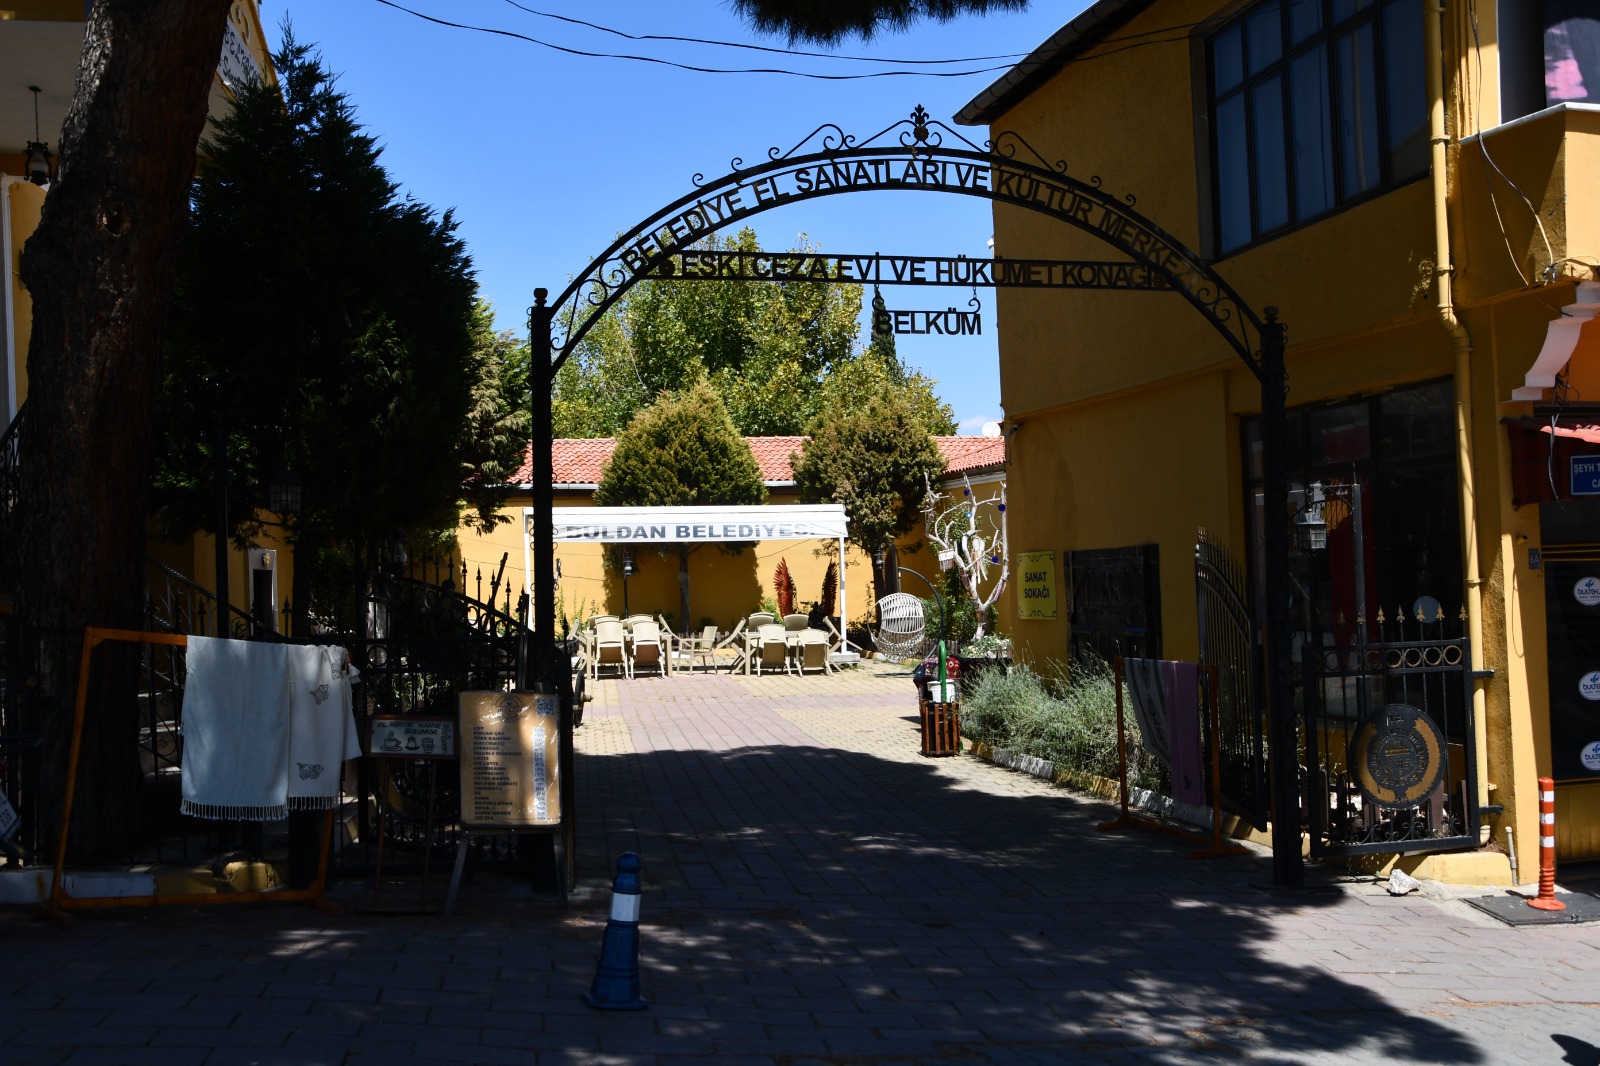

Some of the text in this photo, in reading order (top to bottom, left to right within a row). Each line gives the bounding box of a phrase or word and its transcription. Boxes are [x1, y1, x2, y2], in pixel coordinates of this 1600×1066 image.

[621, 188, 746, 274] BELEDİYE
[752, 176, 790, 205] EL
[795, 159, 946, 195] SANATLARI
[953, 163, 990, 191] VE
[998, 170, 1093, 224] KÜLTÜR
[889, 258, 926, 282] VE
[936, 255, 1057, 286] HÜKÜMET
[875, 308, 981, 335] BELKÜM
[1573, 463, 1595, 475] ŞEYH
[1530, 554, 1539, 564] 6A
[1024, 571, 1047, 583] SANAT
[1024, 585, 1050, 599] SOKAĞI
